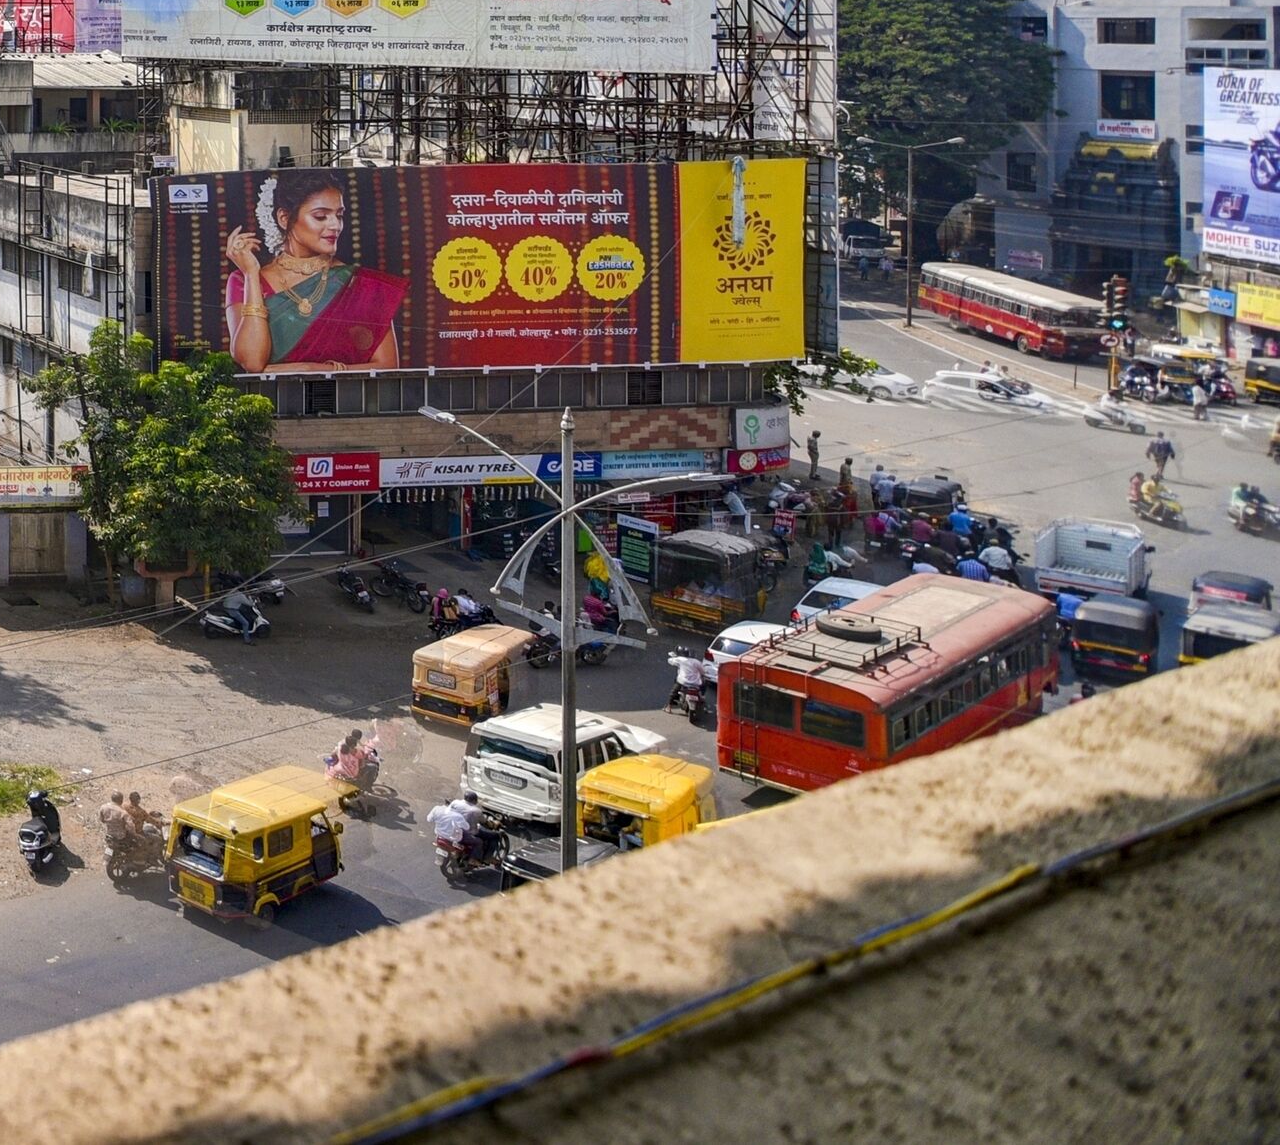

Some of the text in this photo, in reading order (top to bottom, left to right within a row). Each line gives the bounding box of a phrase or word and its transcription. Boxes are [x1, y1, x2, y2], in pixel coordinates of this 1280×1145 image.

[289, 38, 325, 51] कोल्हापूर
[1216, 75, 1265, 91] BORN OF
[450, 188, 625, 209] दसरा-दिवाळीची दागिन्यांची
[445, 208, 630, 230] कोल्हापुरातील सर्वोत्तम ऑफर
[1205, 231, 1251, 248] MOHITE
[715, 275, 774, 294] अनघा
[479, 330, 485, 338] 3
[494, 328, 518, 338] गल्ली,
[561, 327, 577, 337] फोन
[582, 327, 638, 336] 0231-2535677
[433, 462, 517, 475] KISAN TYRES
[328, 479, 371, 487] COMFORT
